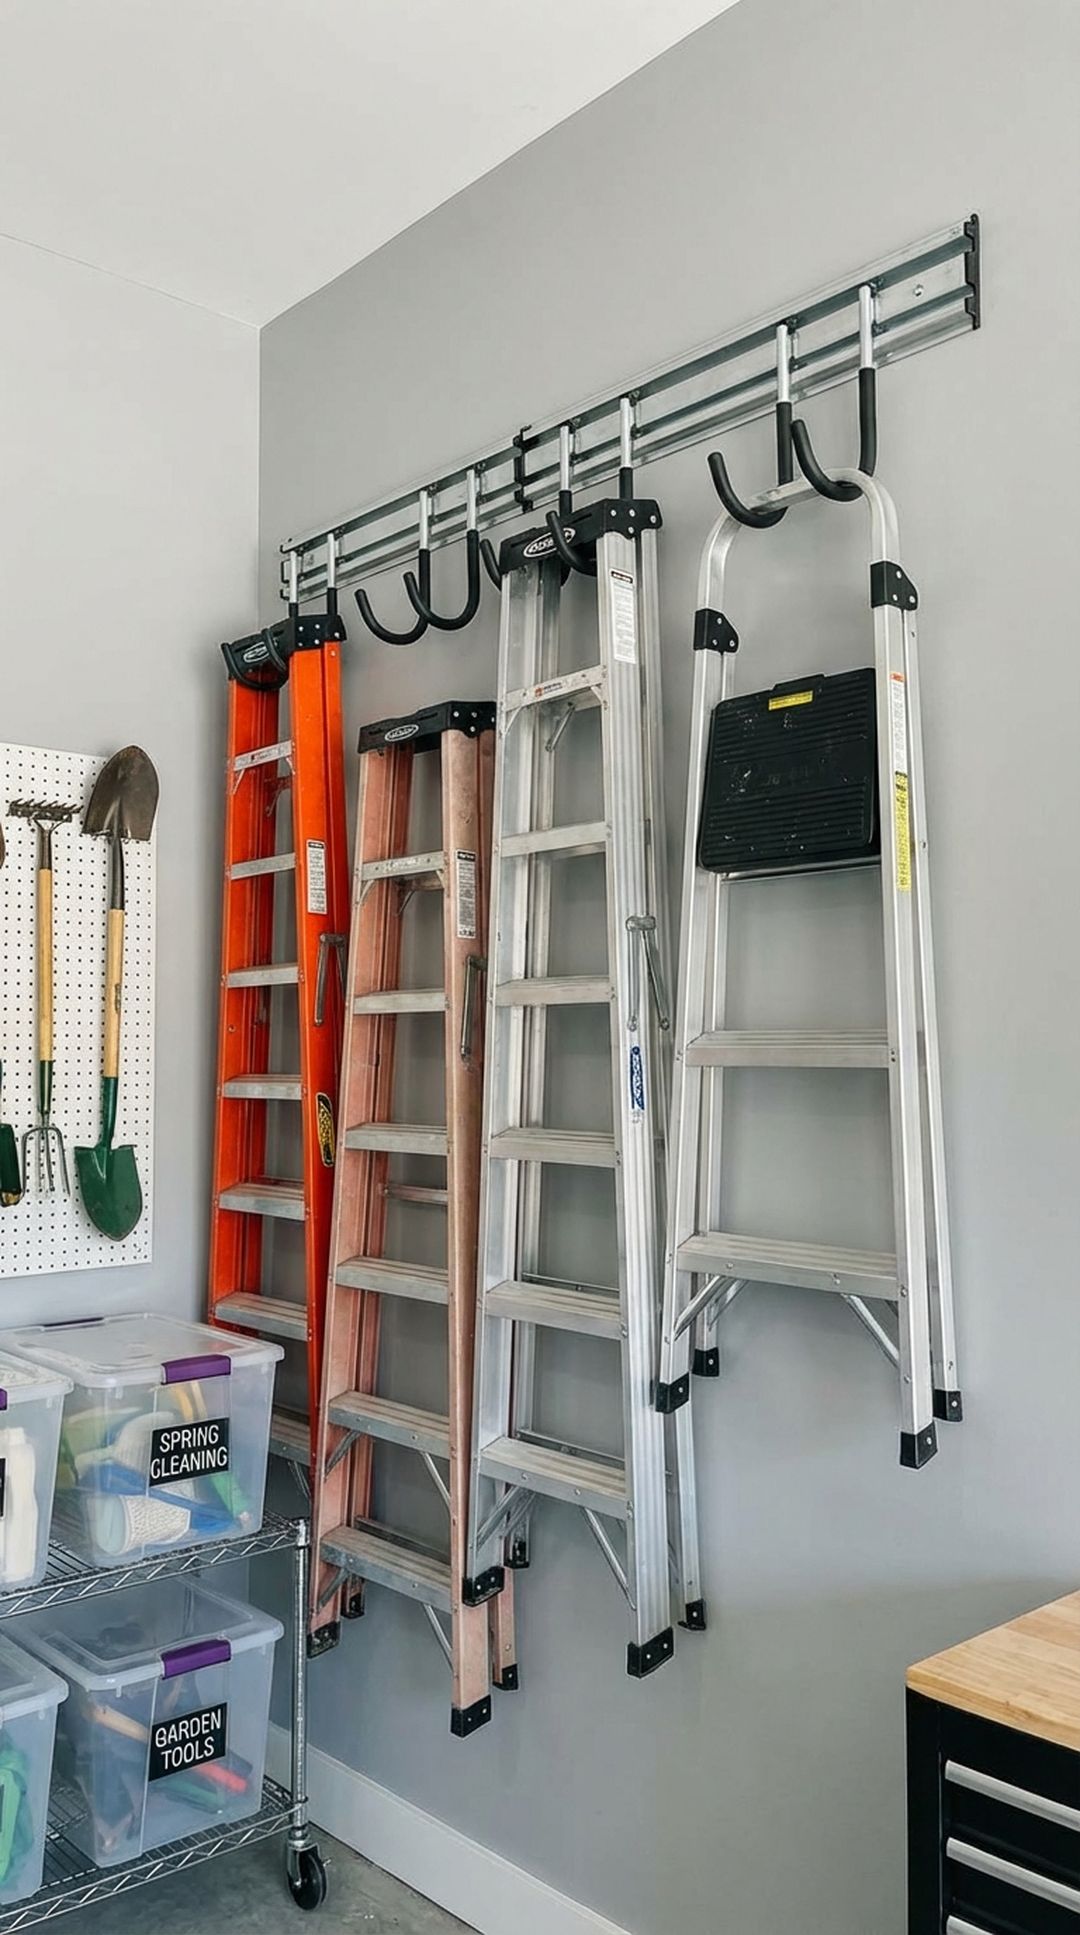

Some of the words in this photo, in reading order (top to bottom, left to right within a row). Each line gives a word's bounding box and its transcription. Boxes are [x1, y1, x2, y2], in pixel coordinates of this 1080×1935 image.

[160, 1425, 219, 1453] SPRING
[151, 1446, 228, 1479] CLEANING
[161, 1736, 214, 1770] TOOLS
